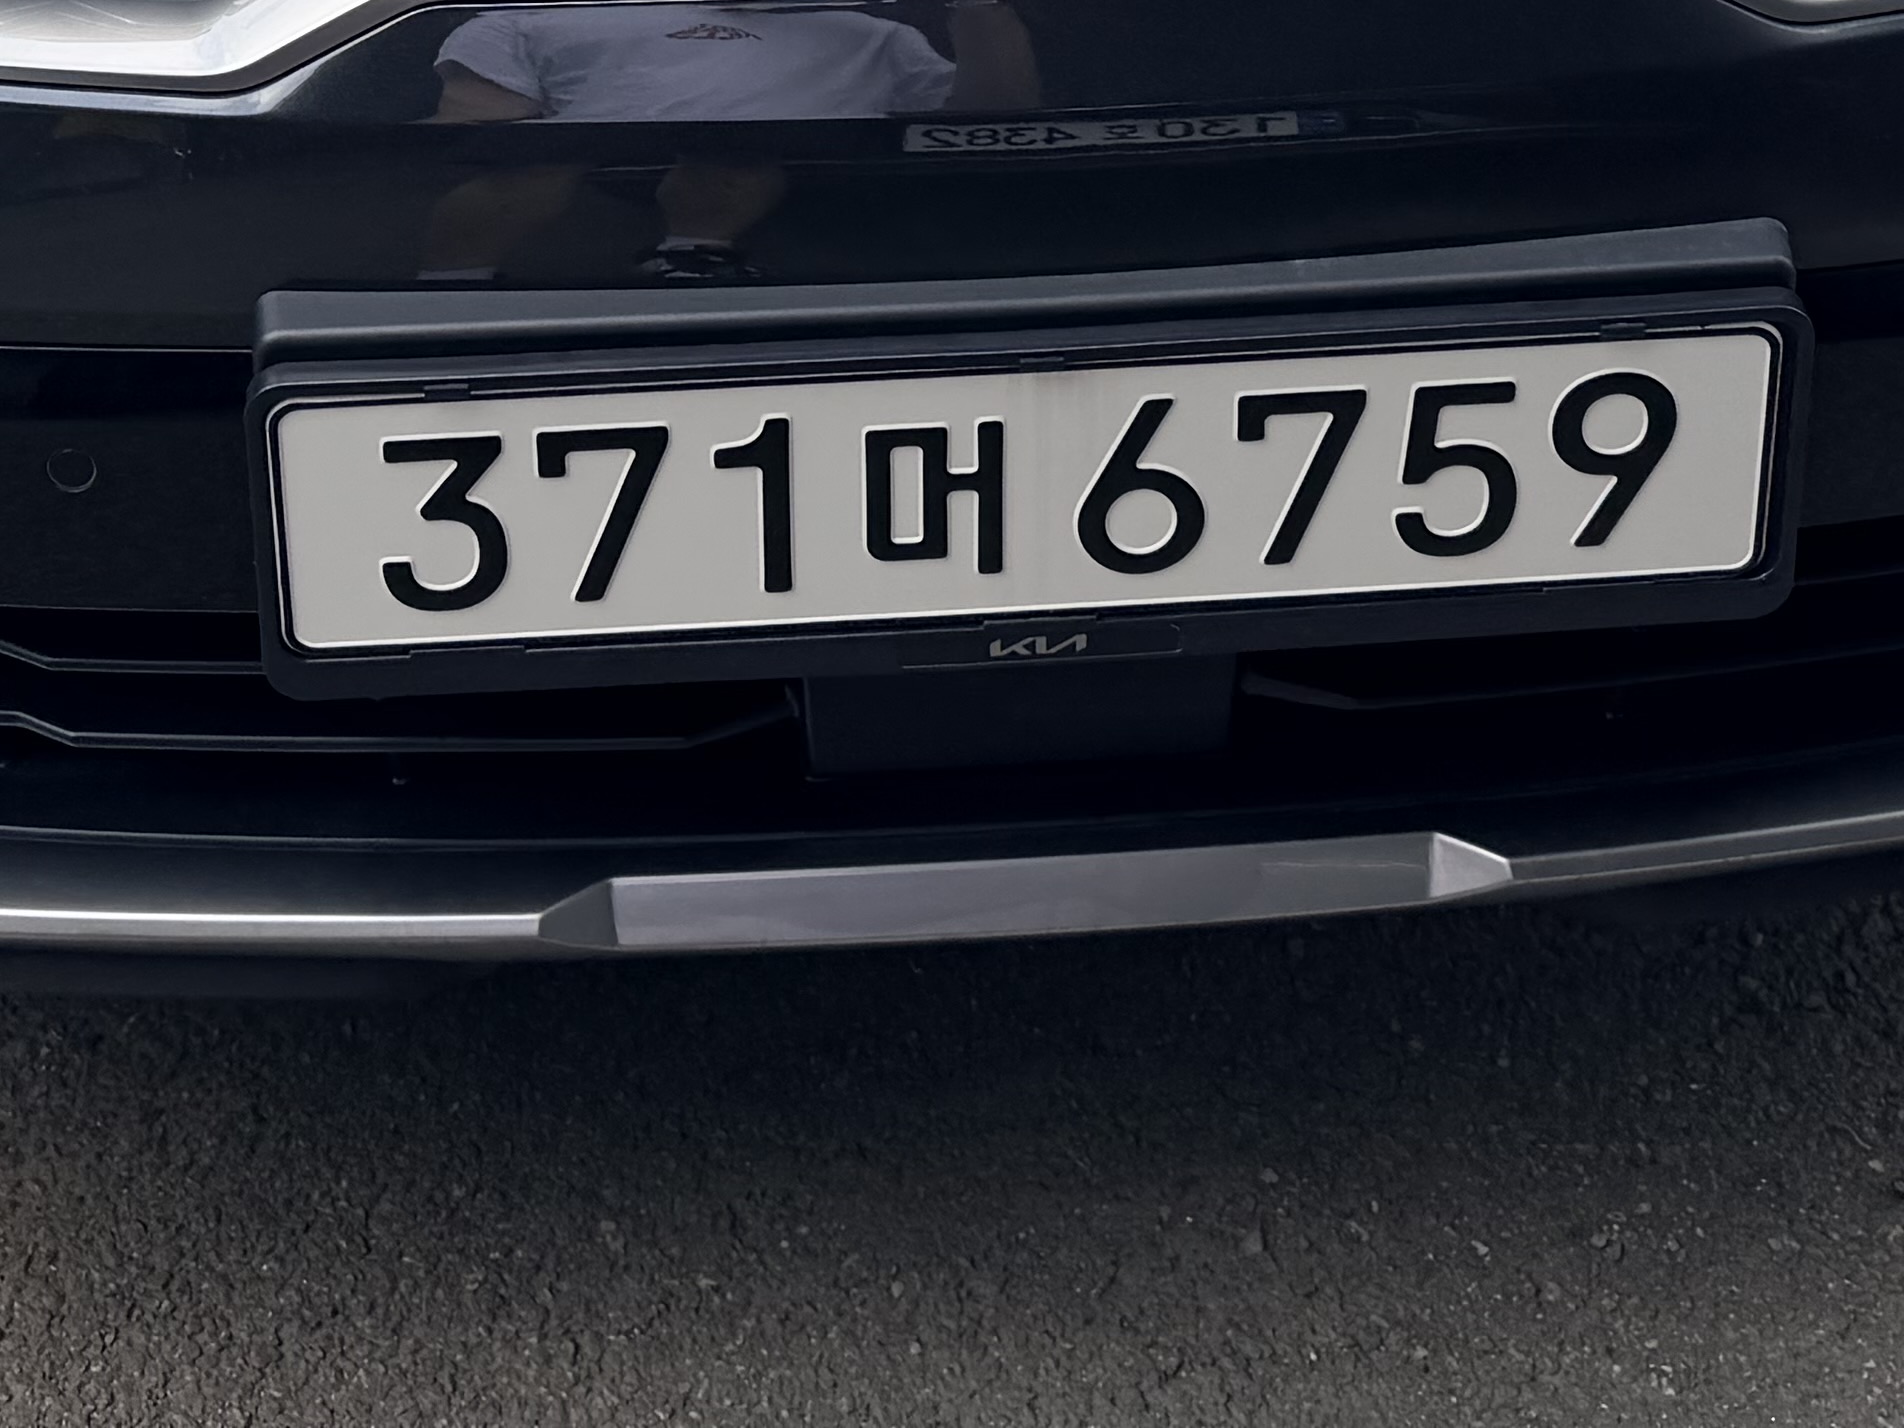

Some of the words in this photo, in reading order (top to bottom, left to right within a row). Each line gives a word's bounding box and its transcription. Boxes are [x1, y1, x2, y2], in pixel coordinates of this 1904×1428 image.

[377, 416, 1005, 612] 371머
[1075, 365, 1681, 575] 6759
[989, 633, 1088, 657] KIA
